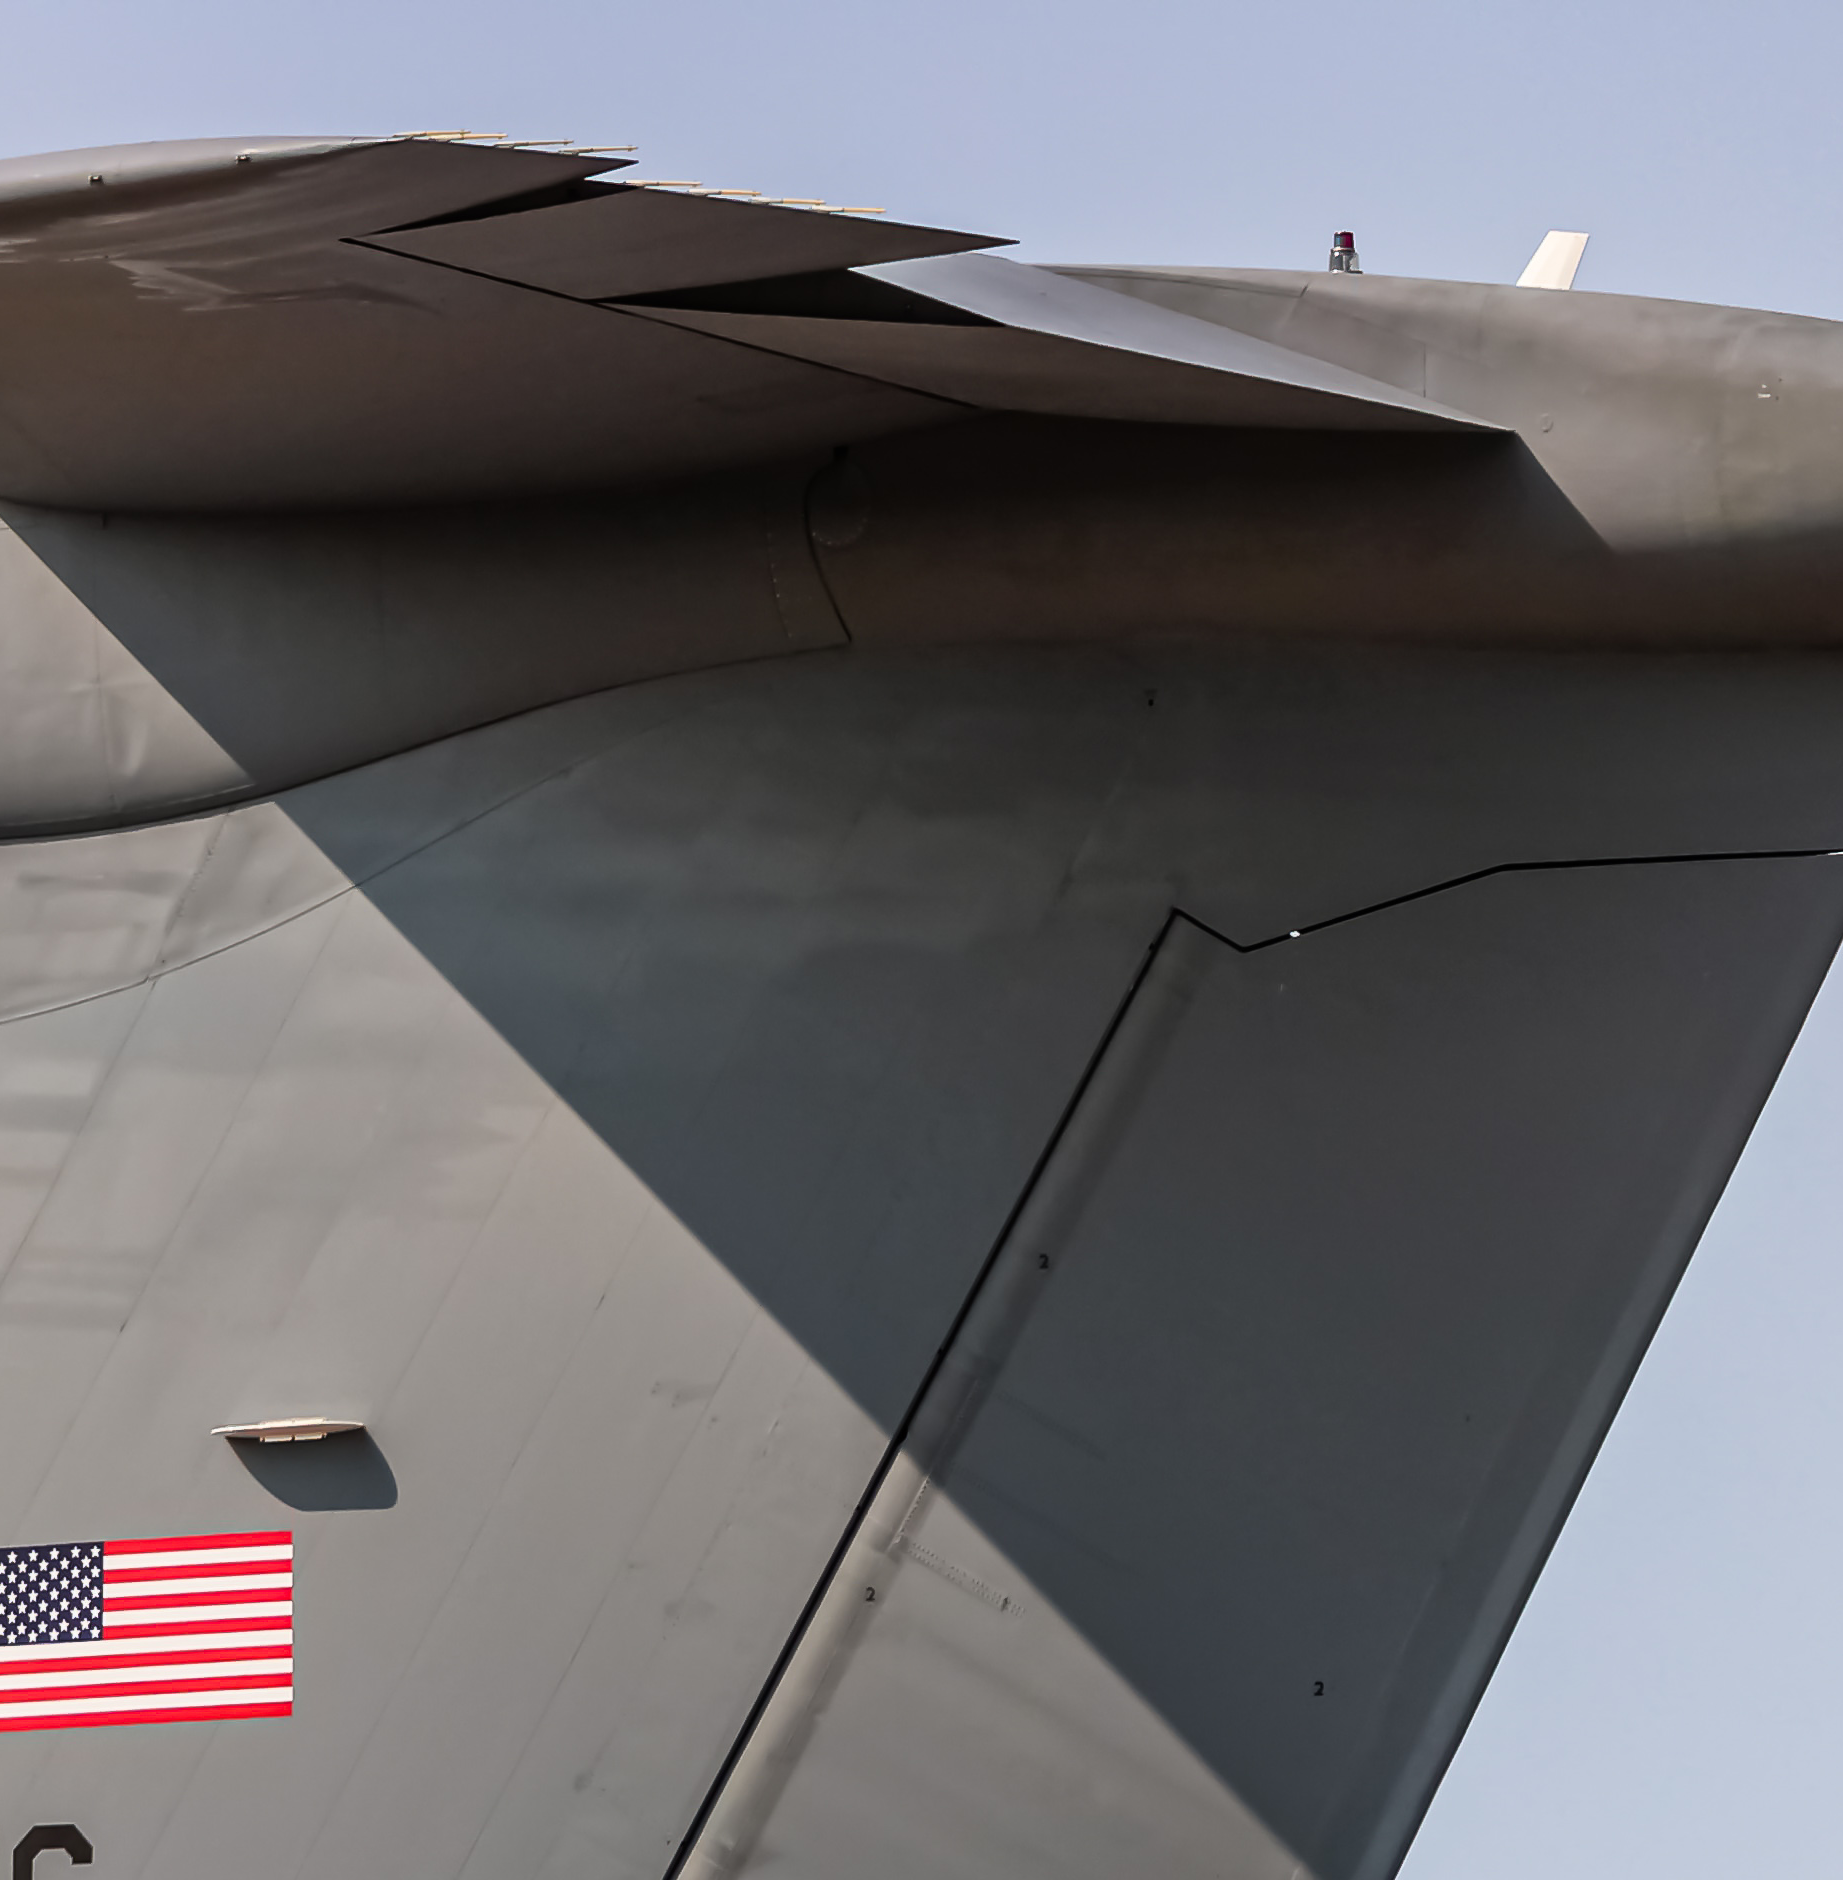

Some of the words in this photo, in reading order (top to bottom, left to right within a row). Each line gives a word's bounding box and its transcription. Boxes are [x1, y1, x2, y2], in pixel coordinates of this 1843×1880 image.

[1038, 1254, 1050, 1270] 2
[865, 1586, 876, 1602] 2
[1313, 1681, 1325, 1697] 2
